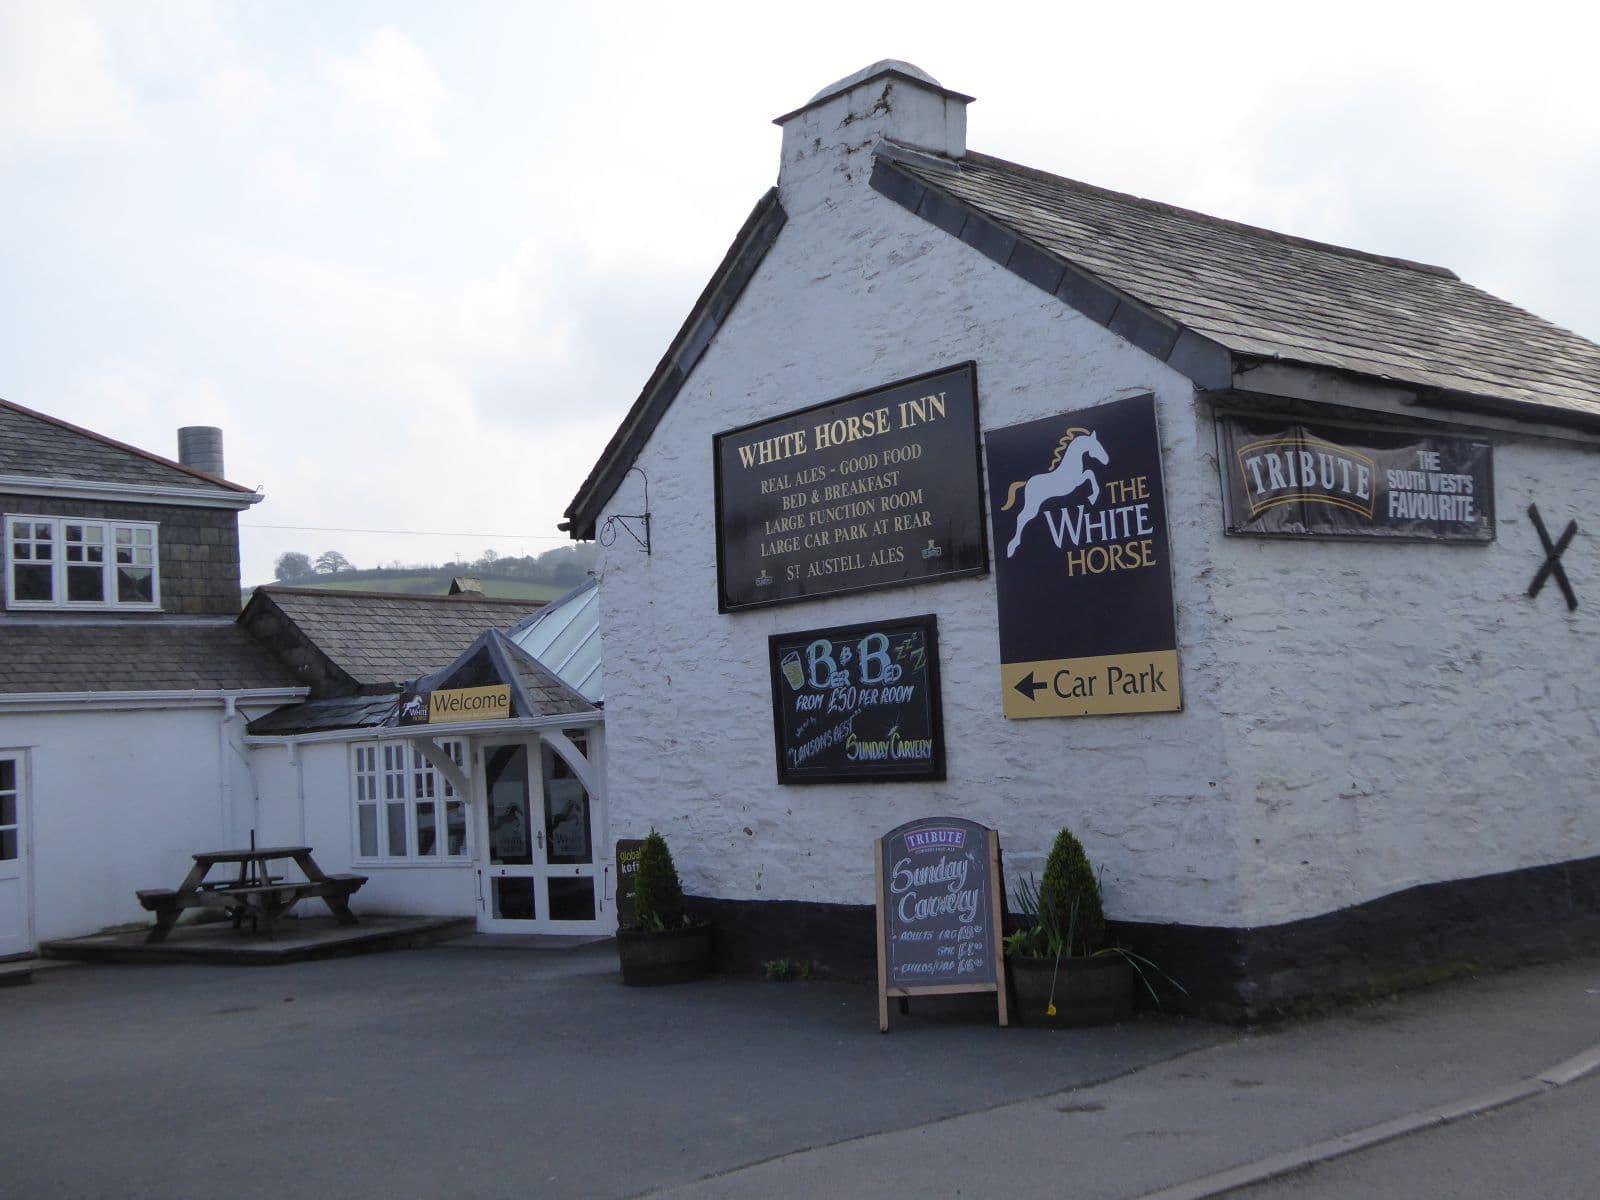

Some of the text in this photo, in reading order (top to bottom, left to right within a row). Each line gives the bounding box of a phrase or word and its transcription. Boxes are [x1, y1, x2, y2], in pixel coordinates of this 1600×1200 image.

[738, 392, 946, 468] WHITE HORSE INN
[761, 474, 791, 494] REAL
[795, 465, 826, 487] ALES
[840, 454, 878, 476] GOOD
[883, 443, 922, 466] FOOD
[1246, 450, 1371, 501] TRIBUTE
[1416, 450, 1441, 471] THE
[783, 471, 900, 511] BED & BREAKFAST
[1105, 476, 1150, 504] THE
[1387, 469, 1426, 491] SOUTH
[765, 488, 923, 535] LARGE FUNCTION ROOM
[1388, 491, 1475, 522] FAVOURITE
[761, 510, 932, 557] LARGE CAR PARK AT REAR
[1044, 503, 1154, 549] WHITE
[807, 554, 864, 579] AUSTELL
[869, 546, 905, 567] ALES
[1067, 539, 1156, 576] HORSE
[1053, 663, 1167, 699] Car Park
[433, 693, 507, 712] Welcome
[796, 685, 914, 714] FROM £50 PER ROOM
[908, 830, 963, 847] TRIBUTE
[891, 855, 969, 893] Sunday
[898, 888, 979, 923] Carvery
